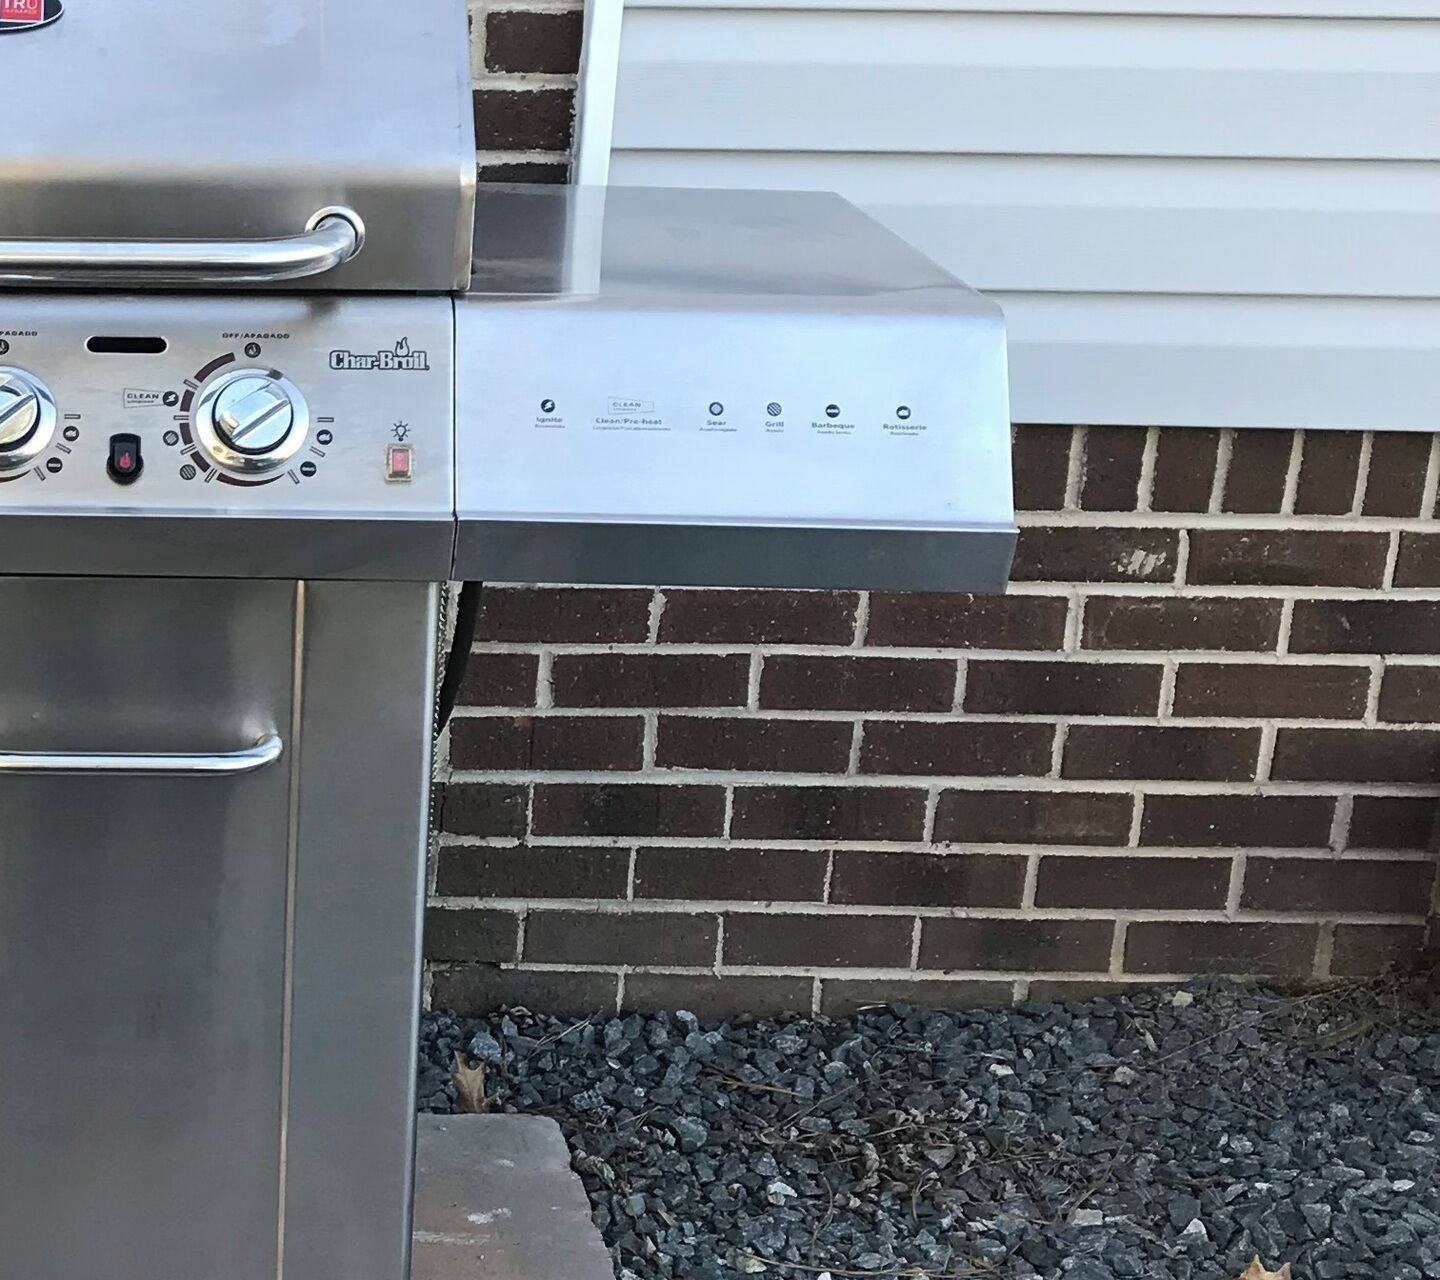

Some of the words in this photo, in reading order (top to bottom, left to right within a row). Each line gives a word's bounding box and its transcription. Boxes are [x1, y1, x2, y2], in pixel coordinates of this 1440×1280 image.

[329, 348, 429, 371] Char-Broil
[536, 416, 563, 424] Ignite
[764, 420, 785, 428] Grill
[811, 422, 855, 430] Barbeque
[882, 423, 928, 431] Rotisserie
